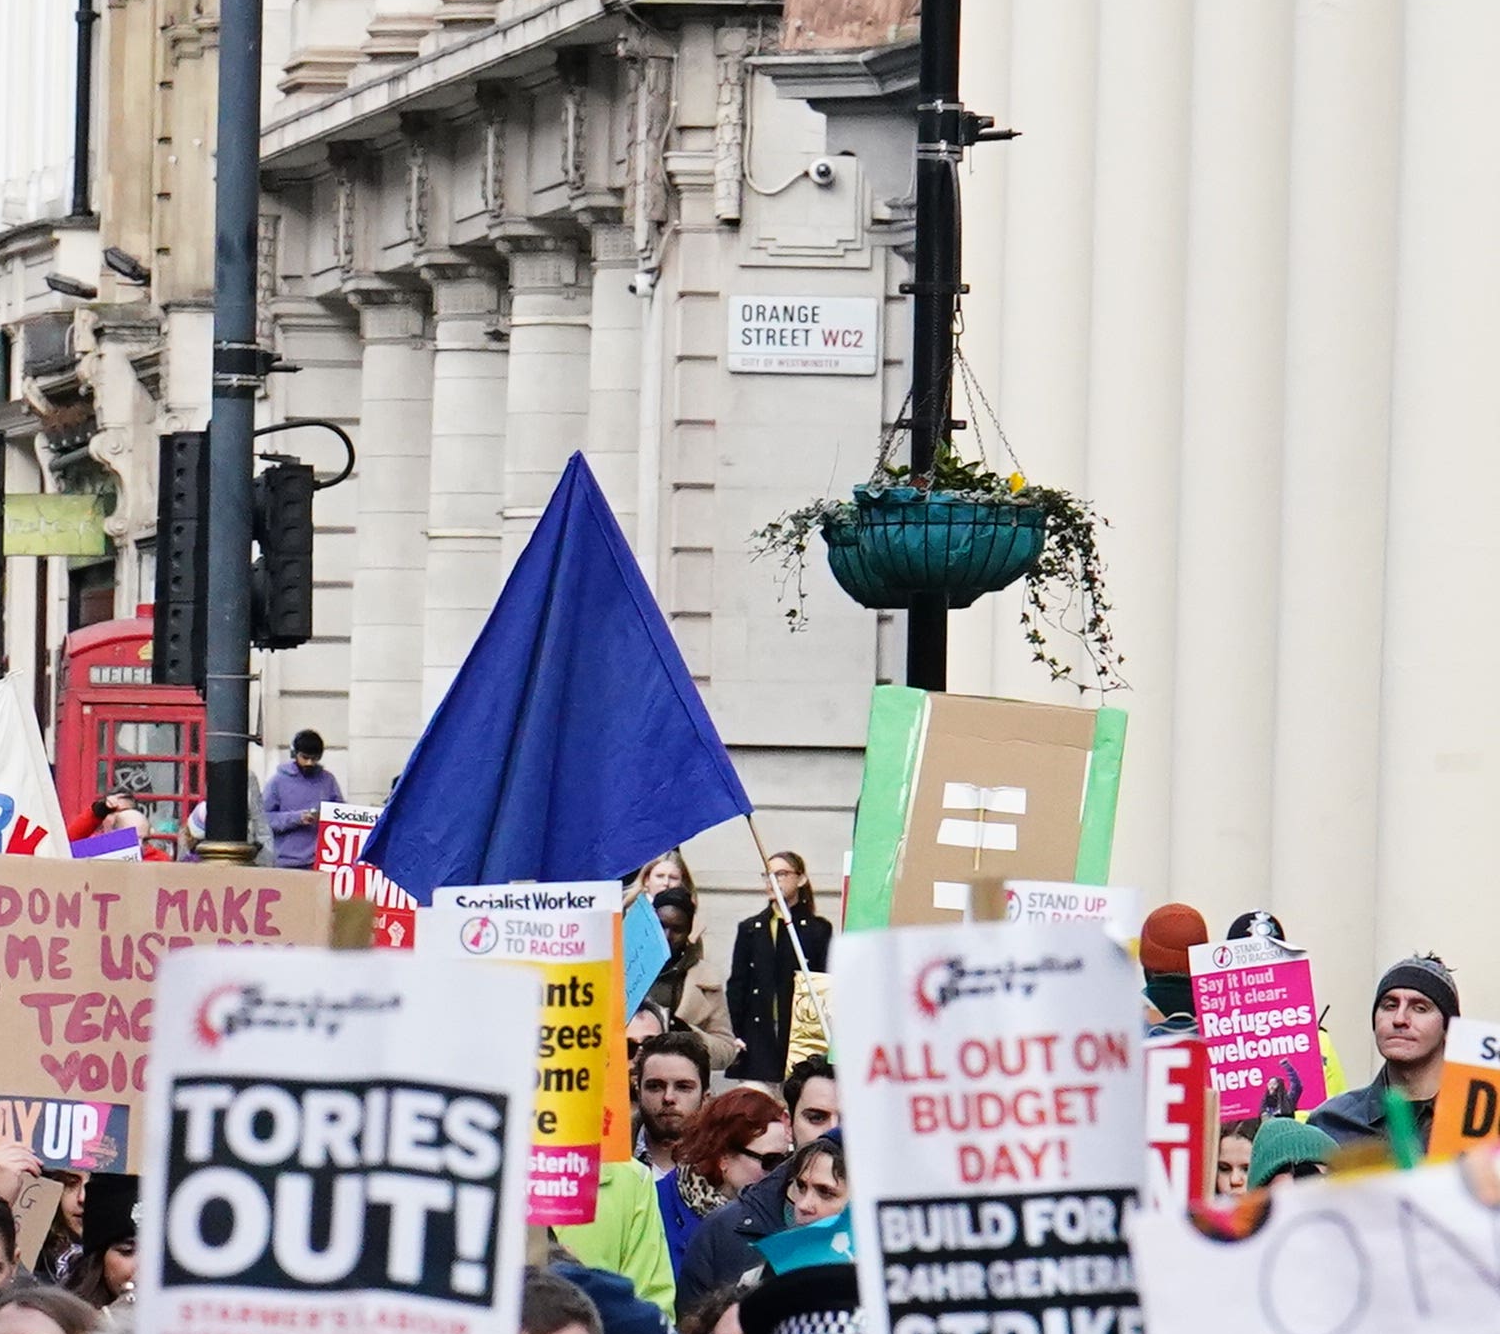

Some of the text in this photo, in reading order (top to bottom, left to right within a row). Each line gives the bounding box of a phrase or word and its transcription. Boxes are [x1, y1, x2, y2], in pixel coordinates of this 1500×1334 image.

[741, 303, 821, 326] ORANGE
[741, 328, 864, 350] STREET WC2
[329, 864, 417, 910] TO WIN
[157, 886, 282, 937] MAKE
[1028, 892, 1108, 915] STAND UP
[505, 921, 579, 939] STAND UP
[505, 937, 585, 956] TO RACISM
[1234, 941, 1262, 955] STAND
[1236, 949, 1283, 964] TO RACISM
[1199, 968, 1274, 994] Say it loud
[1200, 987, 1288, 1012] Say it clear:
[1202, 1004, 1311, 1038] Refugees
[1207, 1033, 1310, 1064] welcome
[1210, 1066, 1263, 1092] here
[909, 1087, 1100, 1135] BUDGET
[42, 1102, 100, 1161] UP
[172, 1084, 499, 1179] TORIES
[958, 1141, 1071, 1185] DAY!
[167, 1171, 496, 1292] OUT!
[882, 1197, 1115, 1252] BUILD FOR
